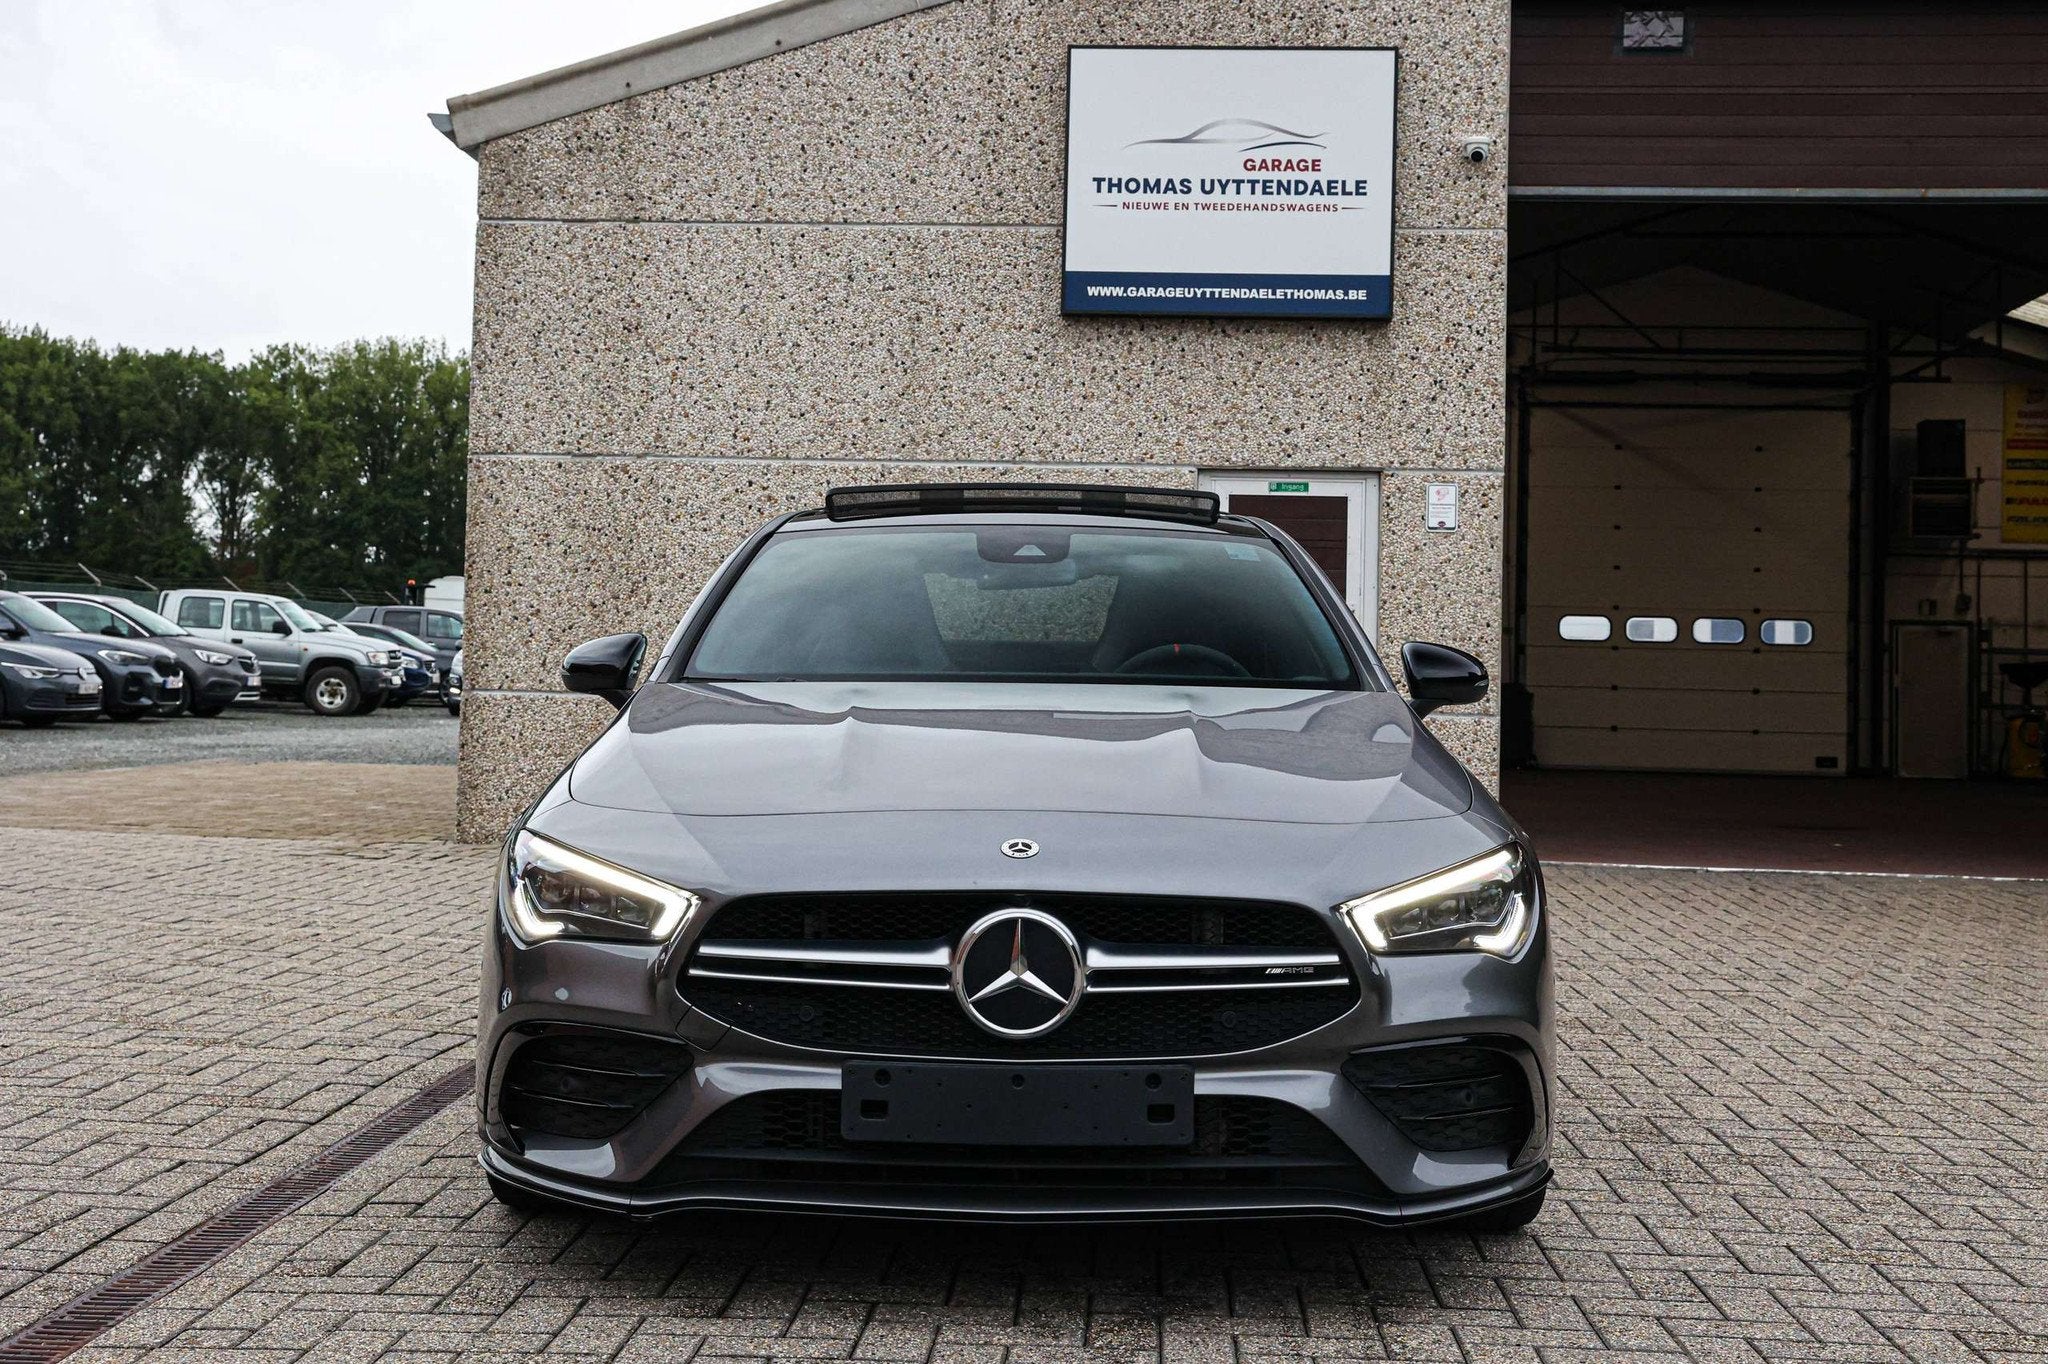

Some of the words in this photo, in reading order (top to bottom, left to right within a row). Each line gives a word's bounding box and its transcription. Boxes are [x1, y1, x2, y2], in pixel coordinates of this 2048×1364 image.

[1243, 158, 1321, 172] GARAGE
[1092, 177, 1192, 195] THOMAS
[1200, 178, 1368, 196] UYTTENDAELE
[1122, 201, 1170, 210] NIEUWE
[1174, 202, 1190, 211] EN
[1194, 202, 1339, 213] TWEEDEHANDSWAGENS
[1087, 286, 1367, 300] WWW.GARAGEUYTTENDAELETHOMAS.BE
[1281, 482, 1305, 492] Ingang
[1281, 966, 1314, 974] AMG
